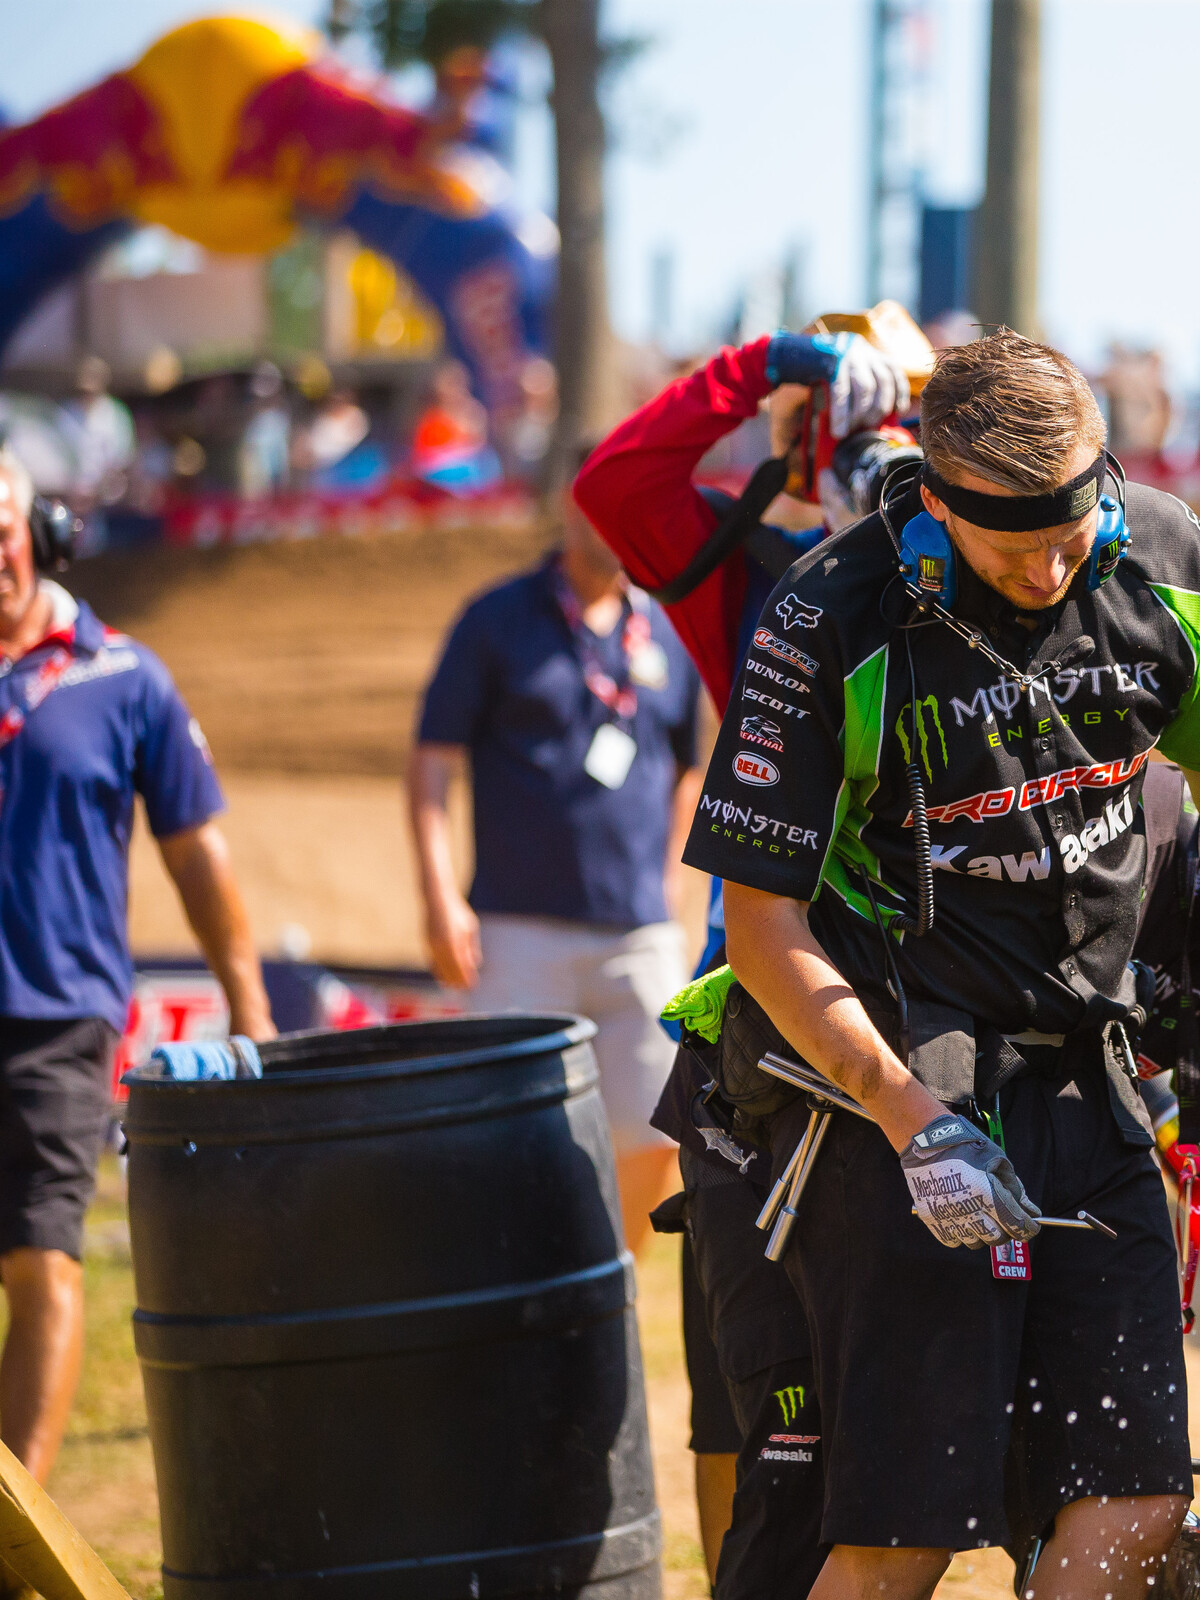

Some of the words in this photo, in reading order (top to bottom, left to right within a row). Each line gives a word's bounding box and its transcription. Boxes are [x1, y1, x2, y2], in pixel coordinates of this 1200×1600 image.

[747, 658, 811, 693] DUNLOP
[743, 688, 811, 719] SCOTT
[950, 661, 1160, 727] MONSTER
[987, 708, 1130, 748] ENERGY
[736, 757, 770, 781] BELL
[700, 794, 818, 850] MONSTER
[901, 787, 1016, 828] PRO
[711, 823, 796, 857] ENERGY
[911, 1169, 968, 1199] Mechanix
[926, 1193, 992, 1222] Mechanix
[998, 1265, 1027, 1278] CREW
